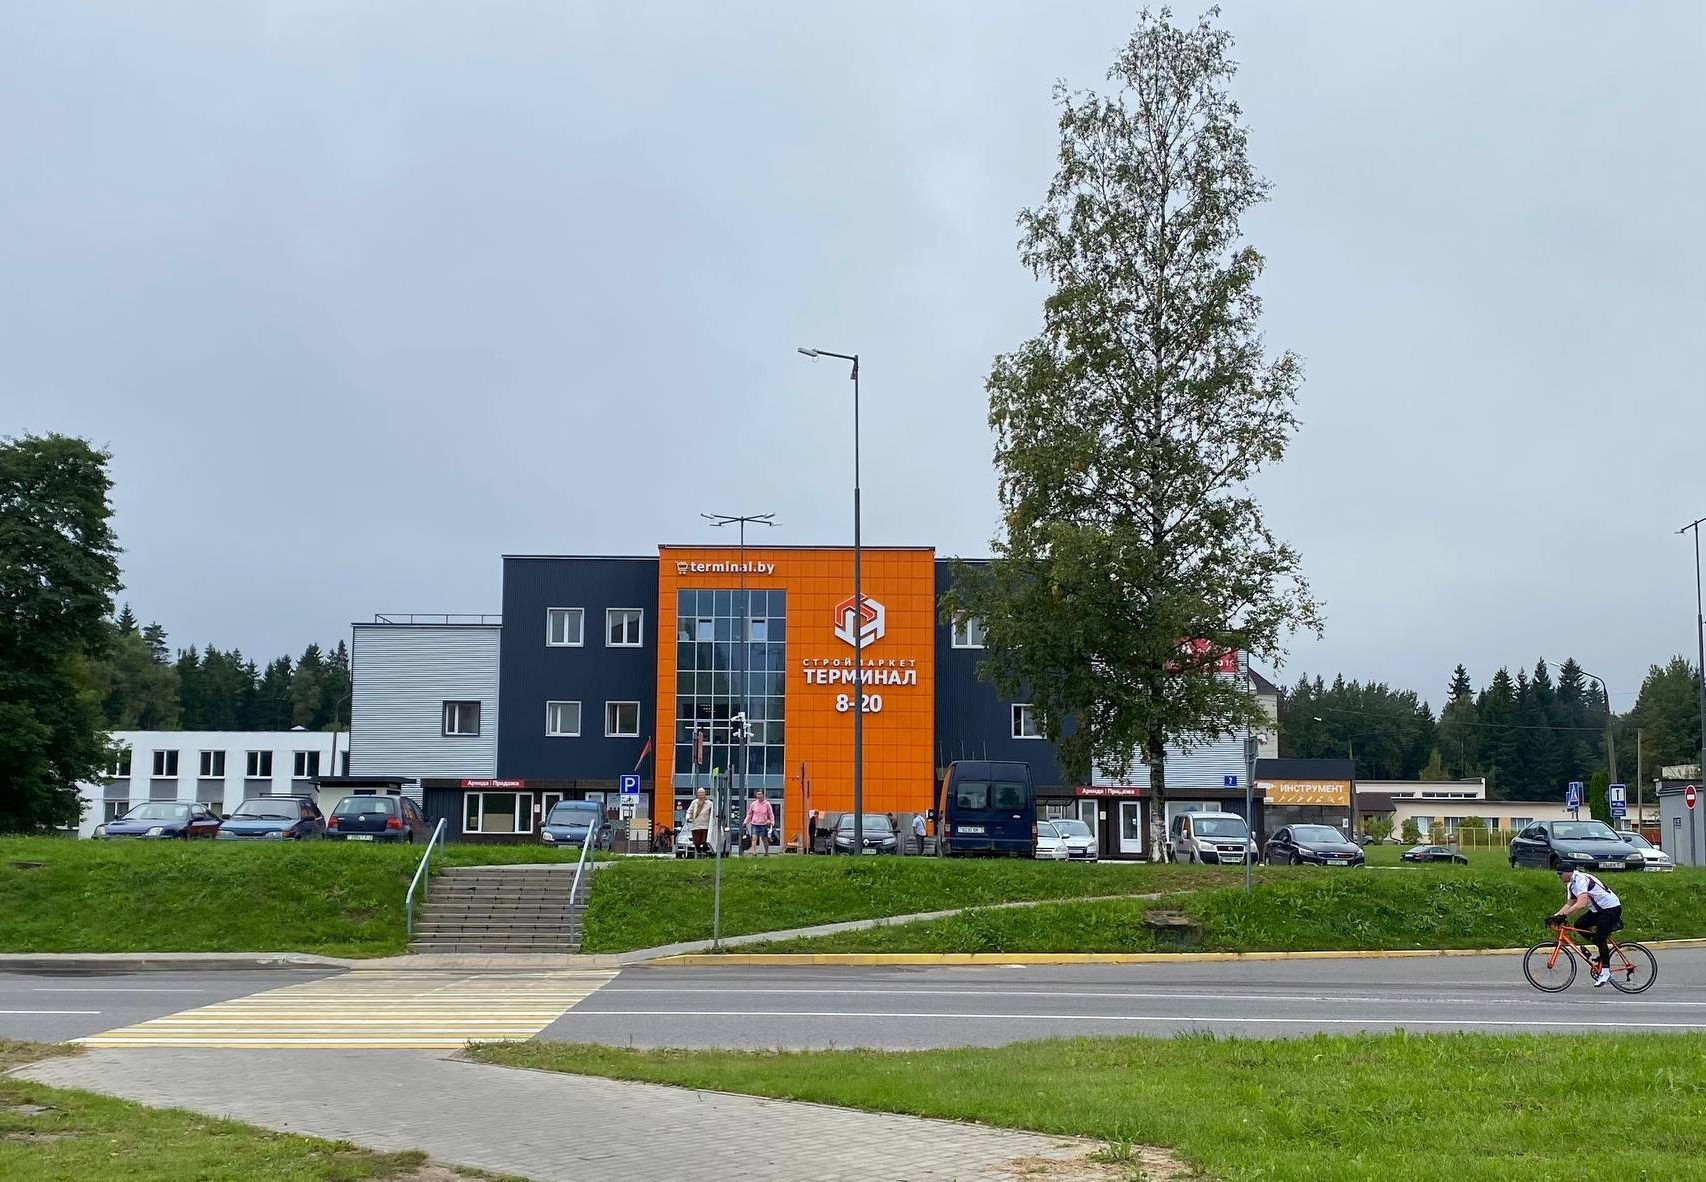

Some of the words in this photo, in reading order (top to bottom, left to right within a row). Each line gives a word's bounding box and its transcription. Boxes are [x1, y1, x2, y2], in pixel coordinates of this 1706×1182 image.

[690, 561, 775, 575] terminal.by
[802, 658, 916, 667] СТРОЙАРКЕТ
[803, 669, 917, 685] ТЕРМИНАЛ
[835, 694, 882, 712] 8-20
[1280, 784, 1344, 793] ИНСТРУМЕНТ
